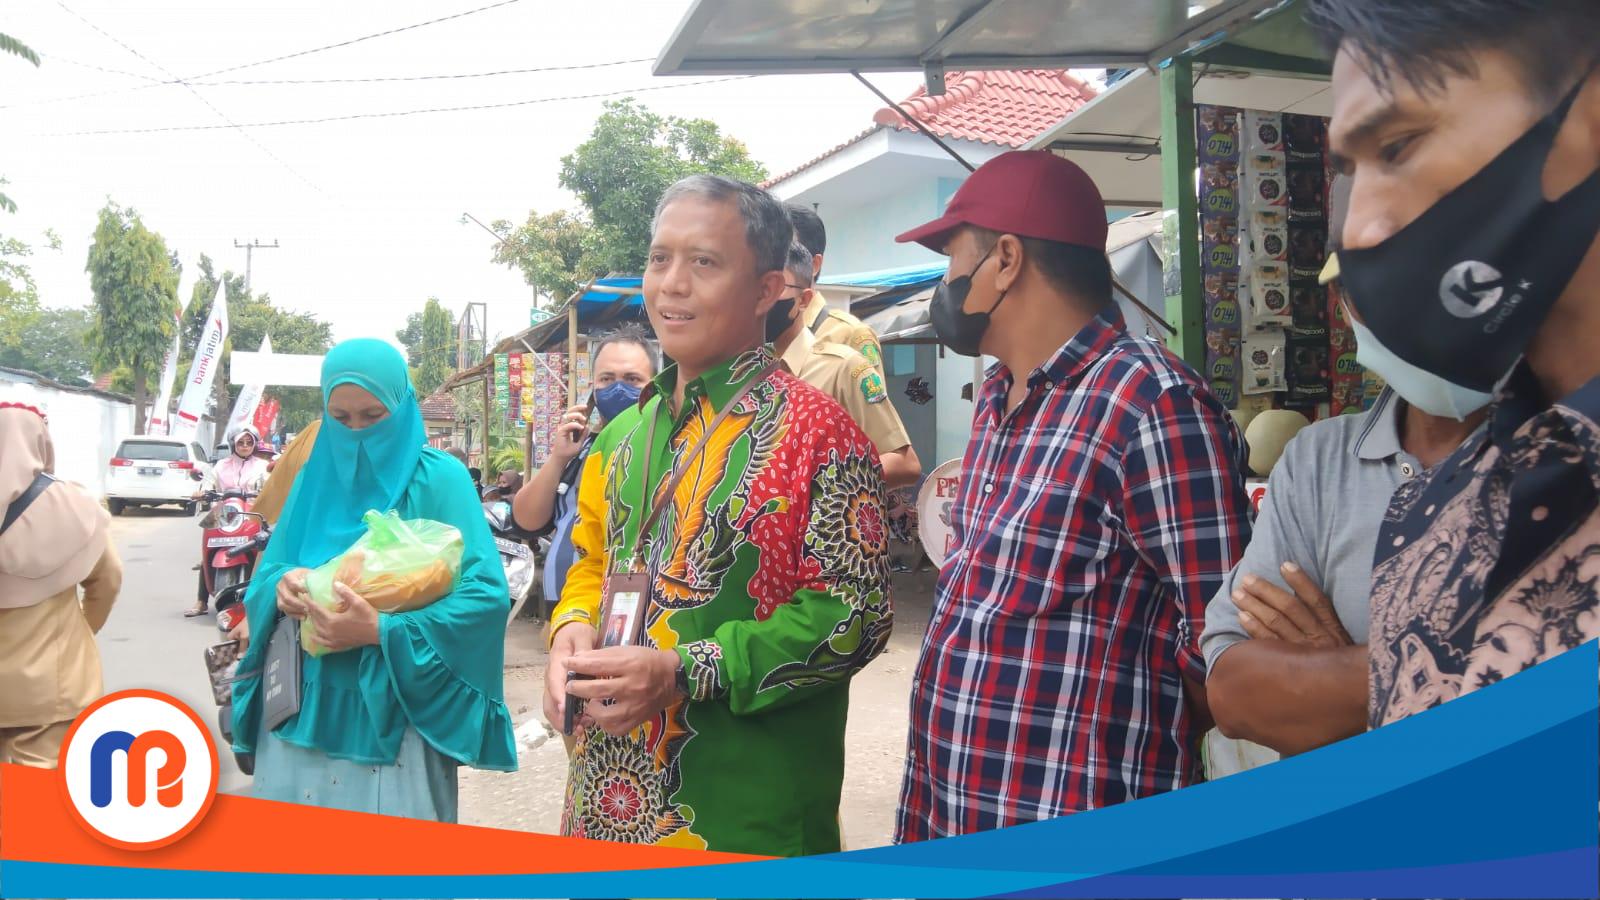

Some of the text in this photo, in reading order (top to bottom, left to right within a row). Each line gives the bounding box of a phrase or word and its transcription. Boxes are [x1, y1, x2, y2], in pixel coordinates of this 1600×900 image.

[1483, 278, 1533, 334] Circle K
[193, 329, 220, 385] bankjatim
